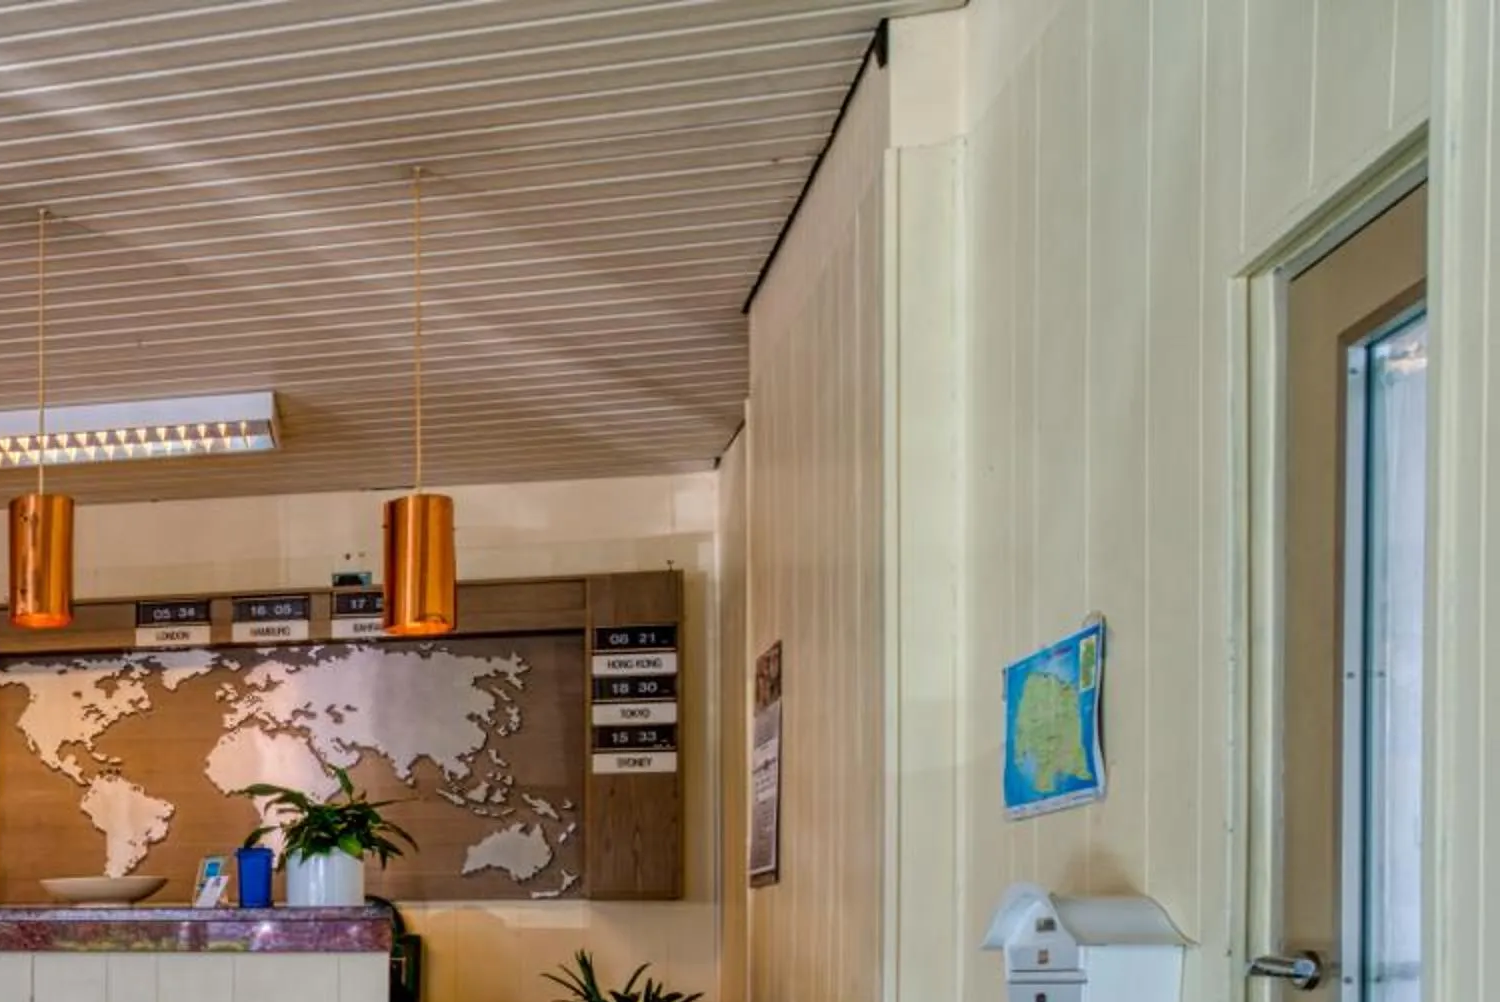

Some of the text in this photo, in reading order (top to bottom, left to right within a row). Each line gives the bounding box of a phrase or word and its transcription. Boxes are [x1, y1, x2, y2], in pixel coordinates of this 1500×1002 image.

[155, 630, 191, 642] LONDON
[249, 625, 292, 638] HAMBURG
[607, 657, 663, 670] HONG KONG
[620, 707, 651, 719] TOKYO
[615, 756, 653, 768] SYDNEY
